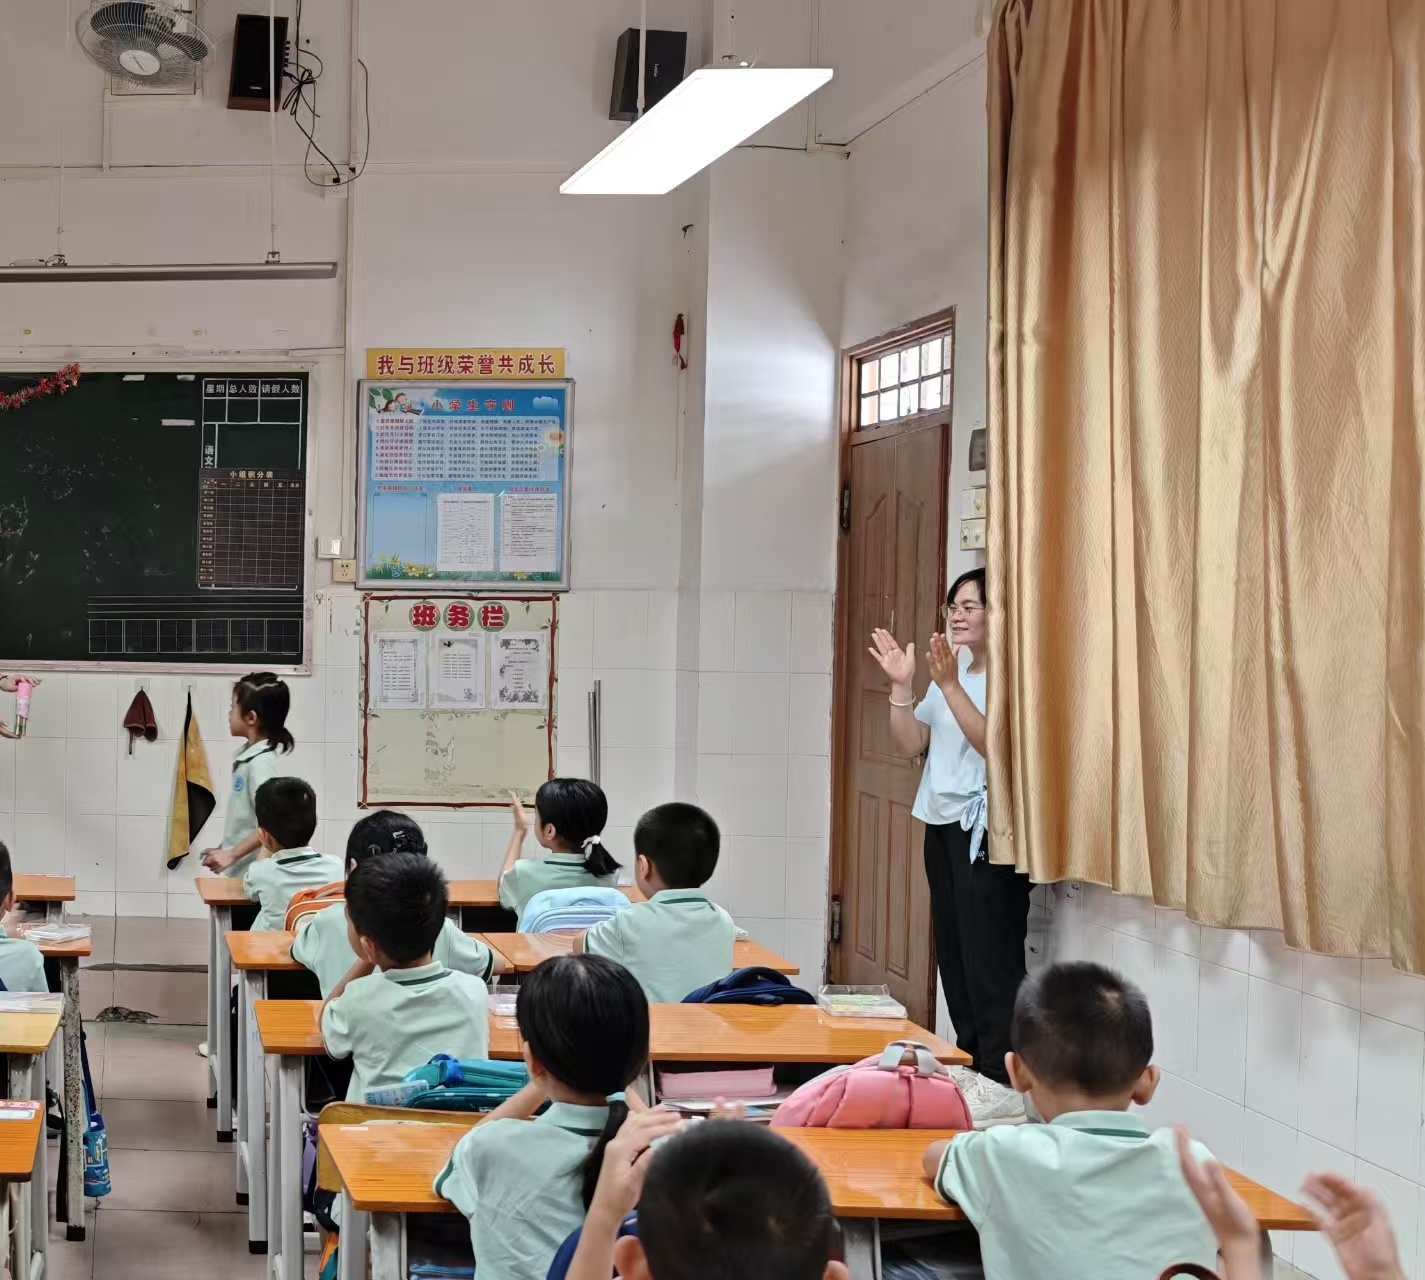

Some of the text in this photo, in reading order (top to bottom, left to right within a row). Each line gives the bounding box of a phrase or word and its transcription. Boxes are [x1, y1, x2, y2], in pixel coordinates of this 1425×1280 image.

[377, 354, 555, 375] 我与班级荣誉共成长
[206, 384, 301, 394] 星期 总人数 请假人数
[431, 399, 515, 412] 小学生守则
[204, 445, 215, 468] 语文
[411, 604, 505, 628] 班务栏
